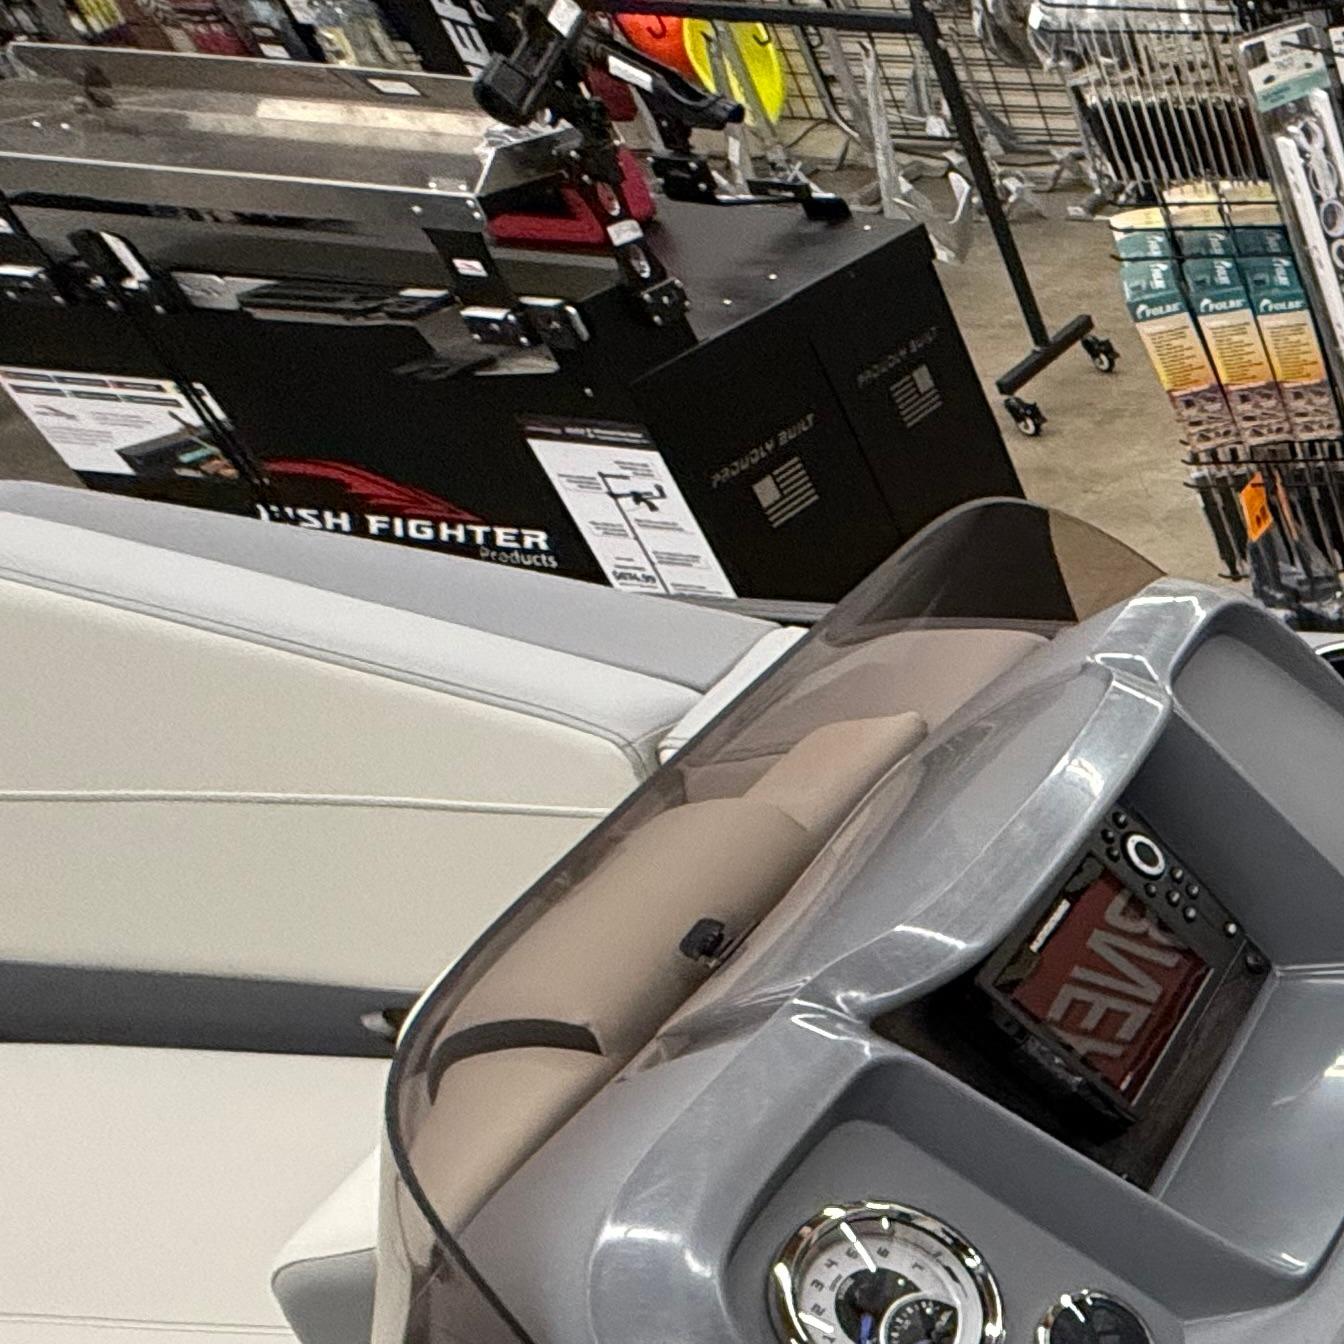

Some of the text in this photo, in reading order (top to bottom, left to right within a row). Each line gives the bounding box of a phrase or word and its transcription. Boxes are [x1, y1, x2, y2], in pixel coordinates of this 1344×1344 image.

[712, 413, 815, 488] PROUDLY BUILT
[365, 513, 550, 551] FIGHTER
[479, 547, 558, 569] Products
[810, 1278, 824, 1292] 3
[811, 1303, 825, 1316] 2
